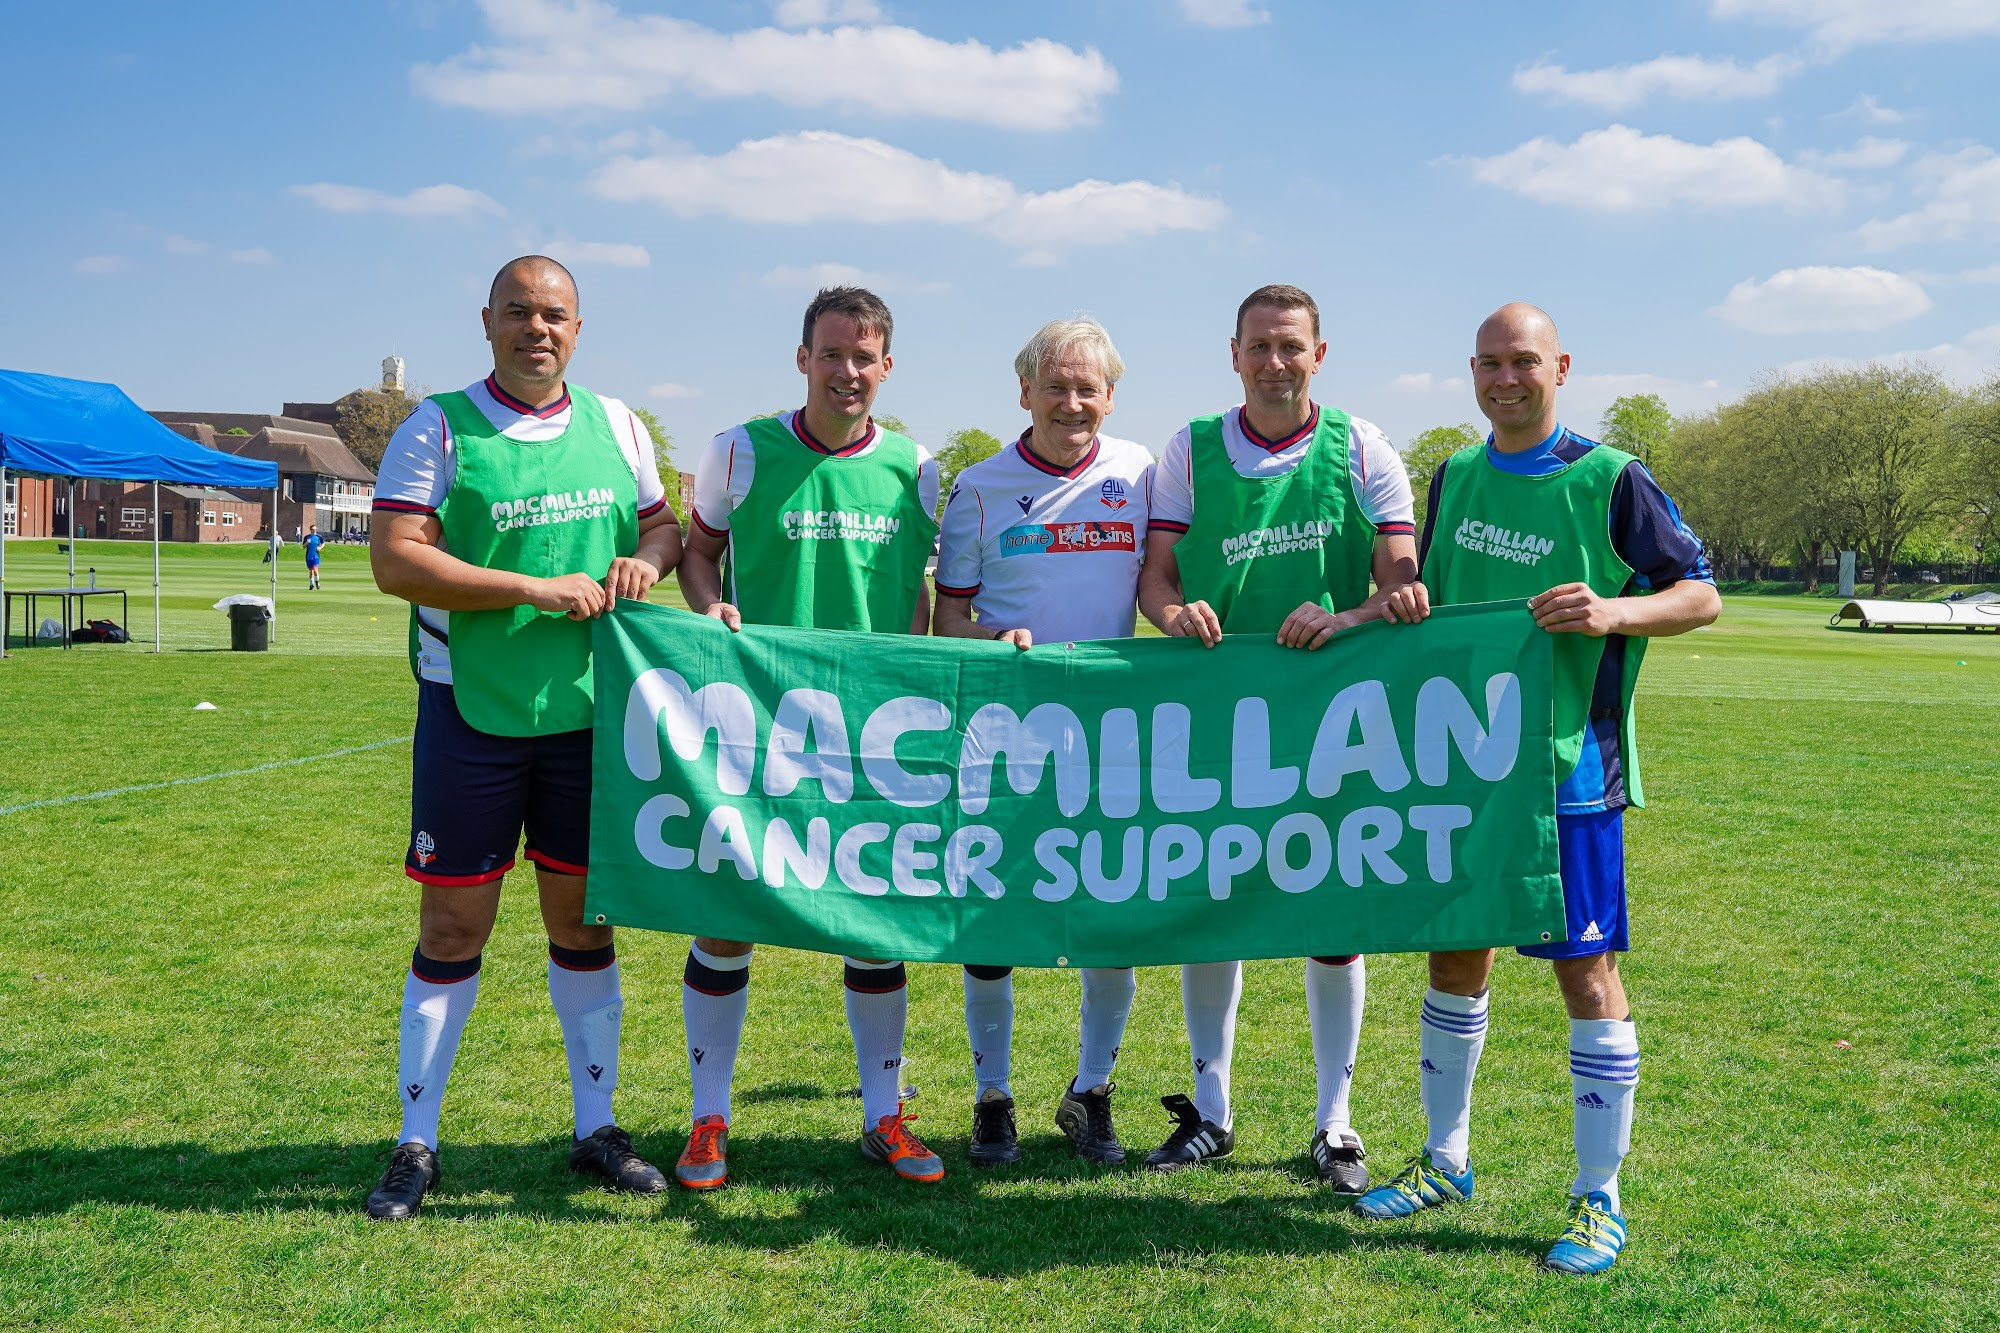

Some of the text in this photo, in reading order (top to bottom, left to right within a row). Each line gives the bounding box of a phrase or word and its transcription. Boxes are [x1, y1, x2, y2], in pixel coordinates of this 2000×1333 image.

[491, 487, 614, 521] MACMILLAN
[496, 505, 610, 533] CANCER SUPPORT
[783, 510, 900, 533] MACMILLAN
[787, 527, 893, 545] CANCER SUPPORT
[1004, 524, 1133, 548] home brgains
[1221, 520, 1333, 556] MACMILLAN
[1226, 537, 1326, 566] CANCER SUPPORT
[1485, 543, 1541, 567] UPPORT
[624, 667, 1522, 819] MACMILLAN
[633, 793, 1473, 903] CANCER SUPPORT
[1575, 1099, 1611, 1109] adidas
